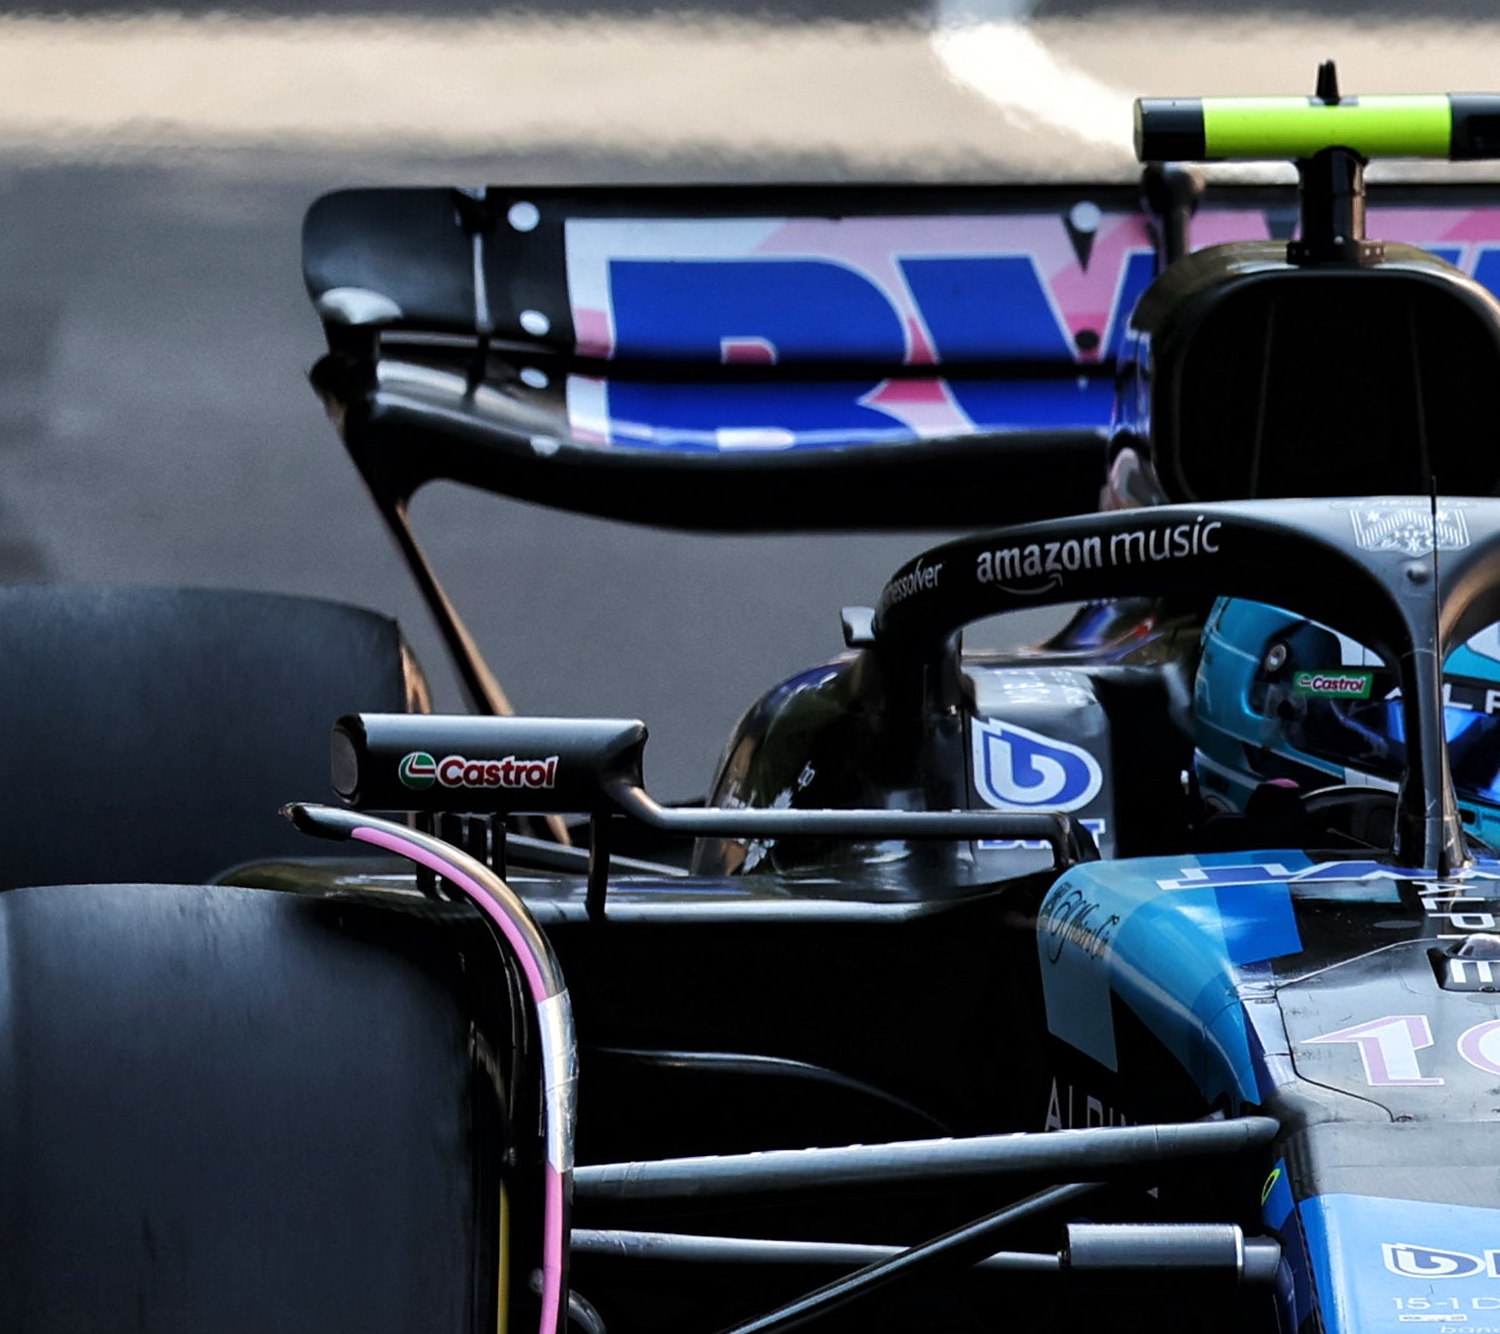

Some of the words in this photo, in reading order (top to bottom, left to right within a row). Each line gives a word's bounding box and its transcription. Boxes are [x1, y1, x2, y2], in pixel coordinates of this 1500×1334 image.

[976, 536, 1102, 584] amazon
[1110, 515, 1222, 567] music
[1312, 674, 1366, 693] Castrol
[437, 755, 559, 788] Castrol
